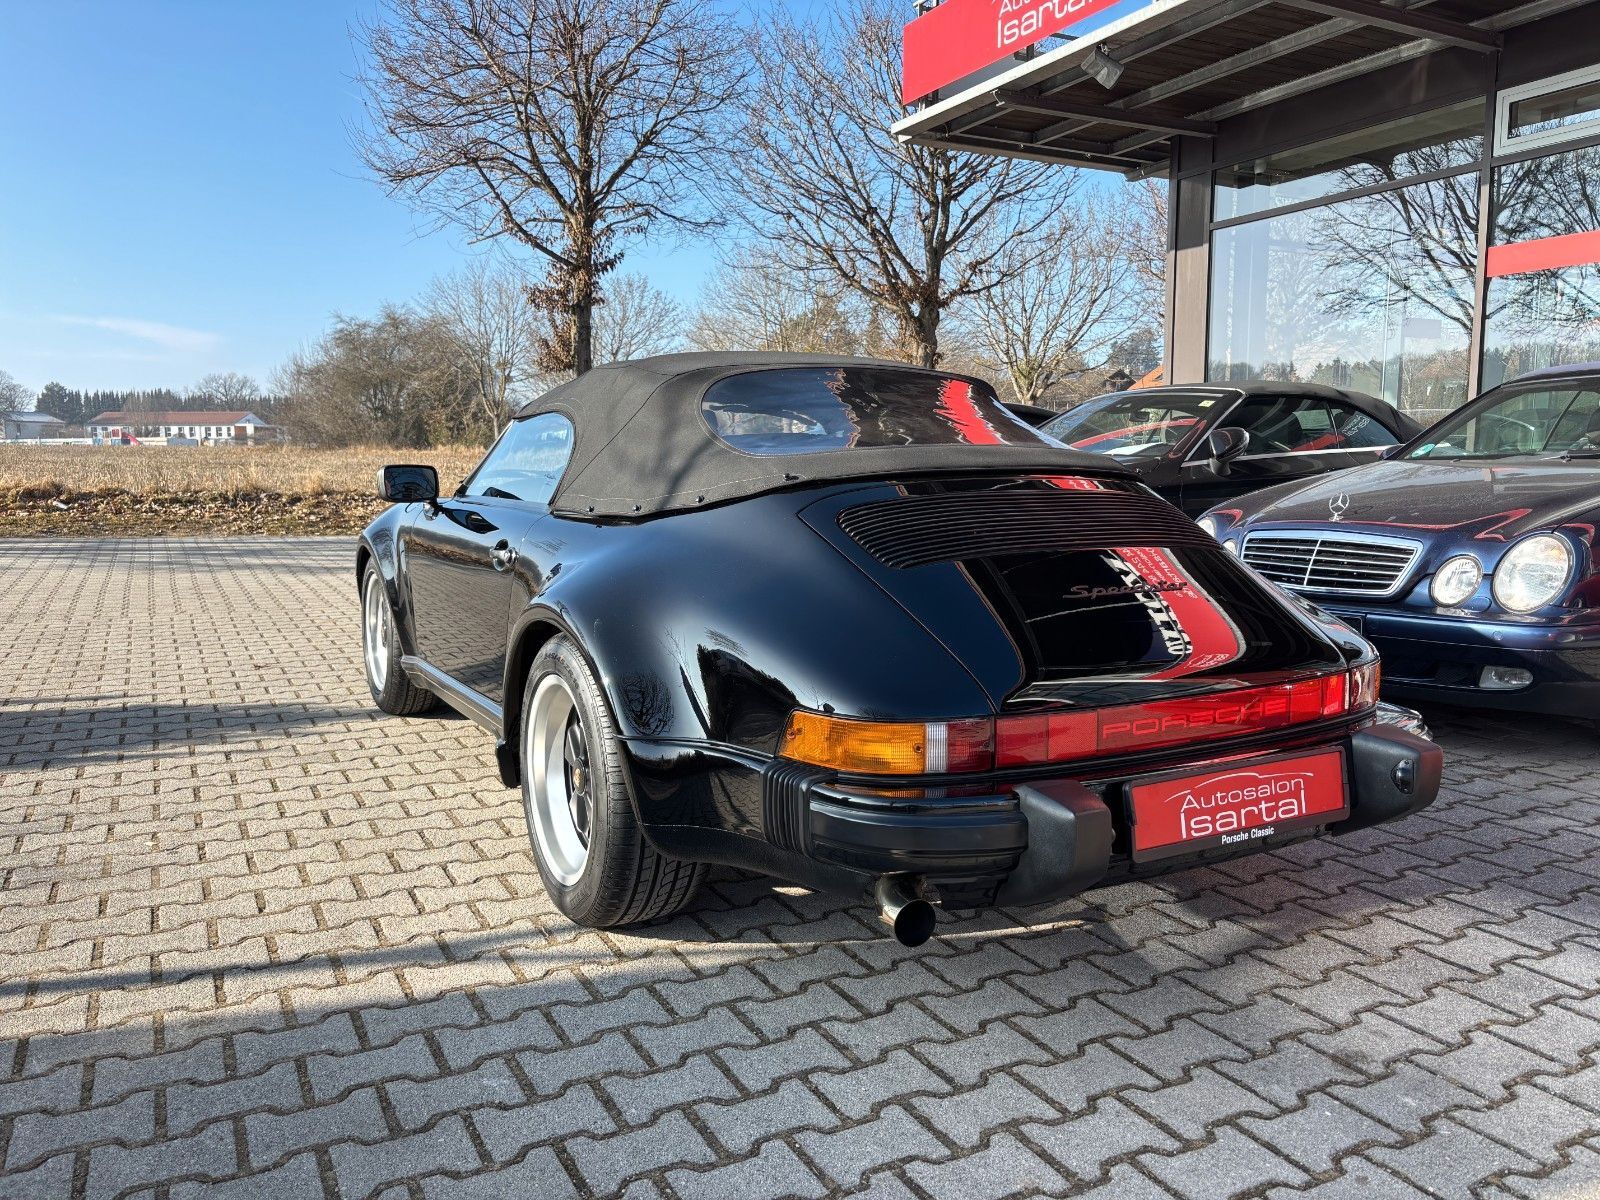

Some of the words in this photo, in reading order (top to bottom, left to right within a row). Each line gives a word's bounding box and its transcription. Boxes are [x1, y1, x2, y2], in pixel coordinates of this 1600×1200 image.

[998, 0, 1094, 48] Isart
[1102, 697, 1287, 738] PORSCHE
[1180, 778, 1304, 812] Autosalon
[1180, 789, 1306, 839] Isartal
[1221, 831, 1249, 845] Porsche
[1250, 826, 1275, 839] Classic
